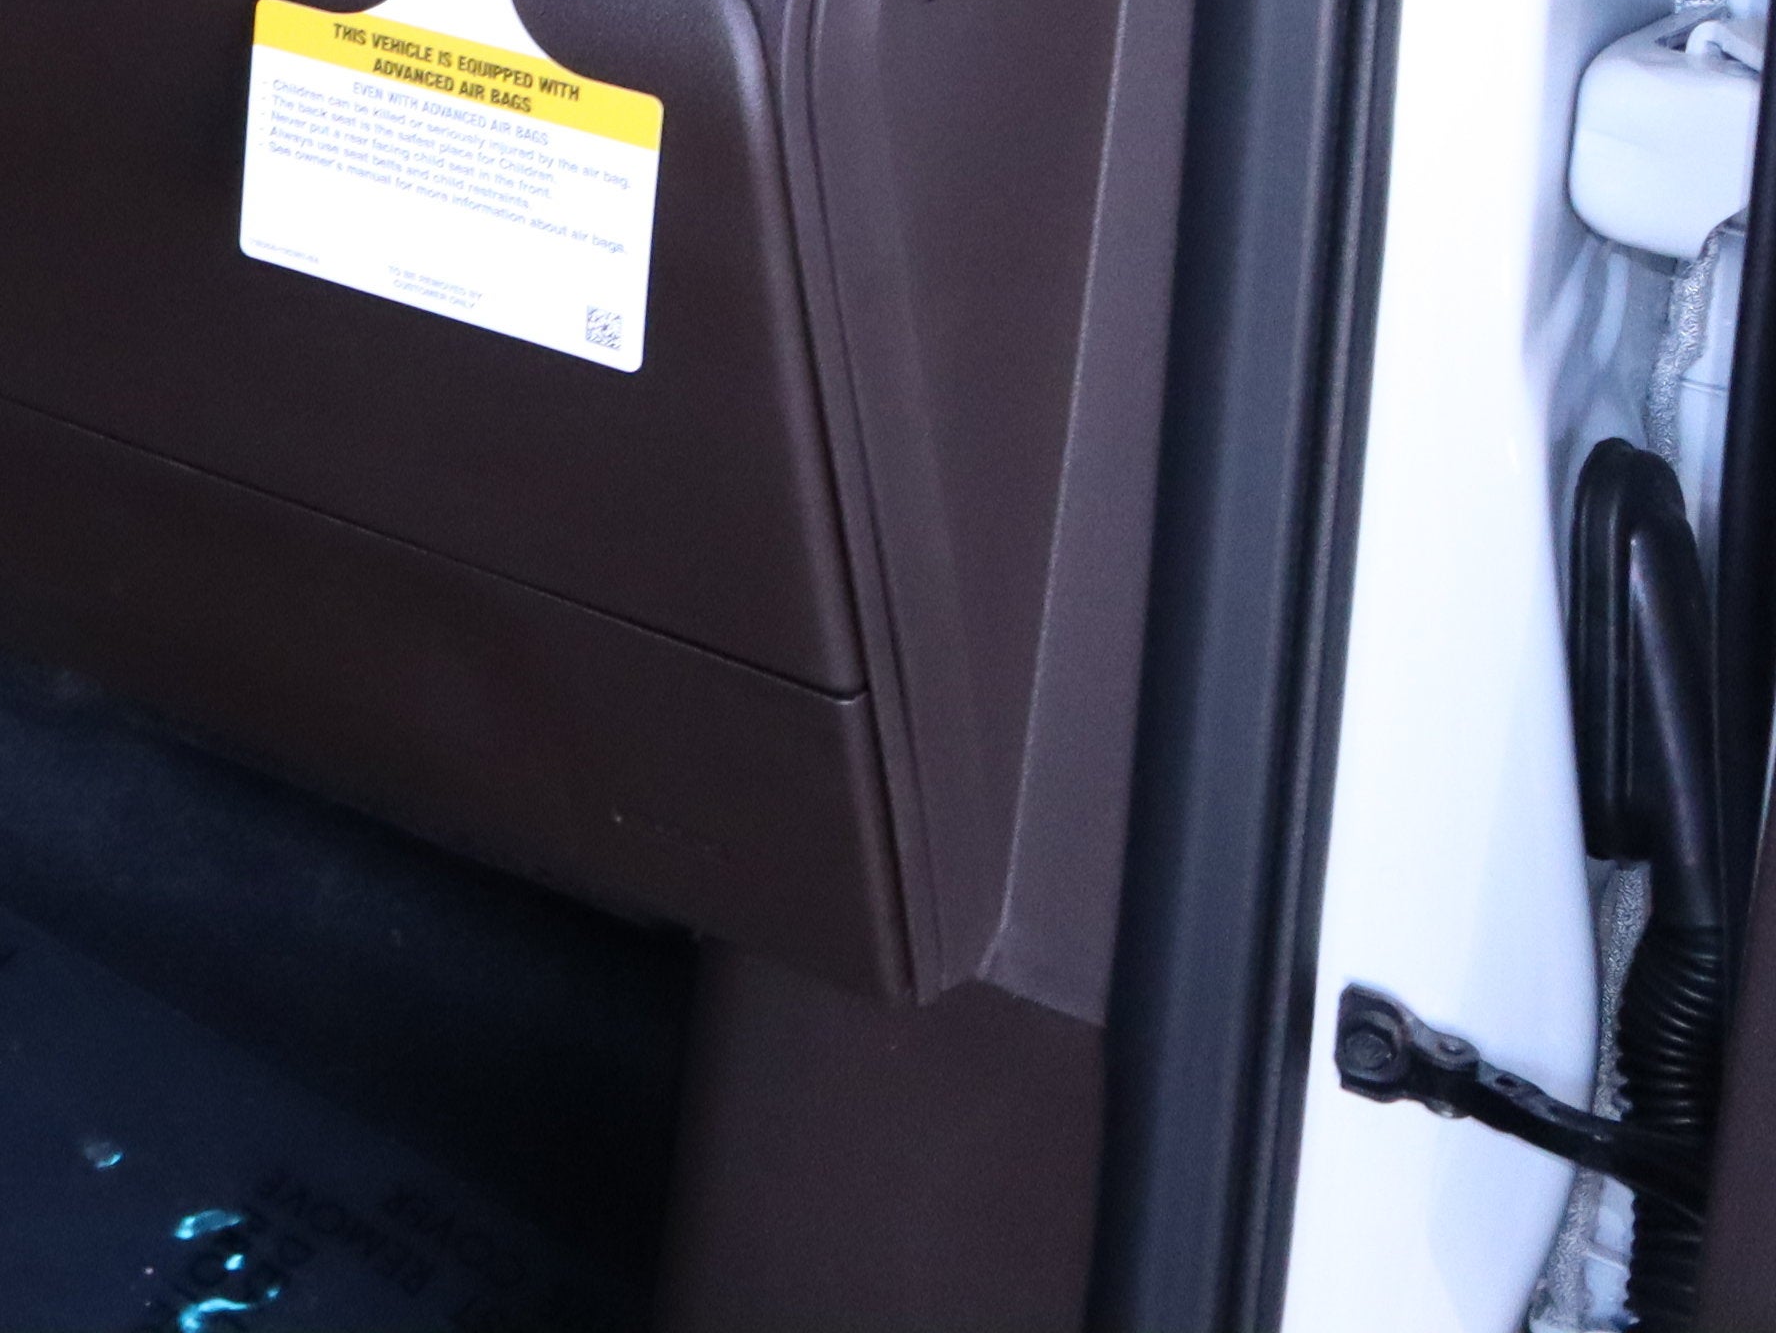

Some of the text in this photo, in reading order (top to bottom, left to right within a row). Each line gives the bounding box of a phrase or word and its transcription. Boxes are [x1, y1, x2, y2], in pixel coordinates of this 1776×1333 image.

[334, 23, 580, 101] THIS VEHICLE IS EQUIPPED WITH
[373, 58, 531, 113] ADVANCED AIR BAGS
[273, 79, 630, 189] Children can be killed or seriously injured by the air bag.
[353, 82, 548, 146] EVEN WITH ADVANCED AIR BAGS
